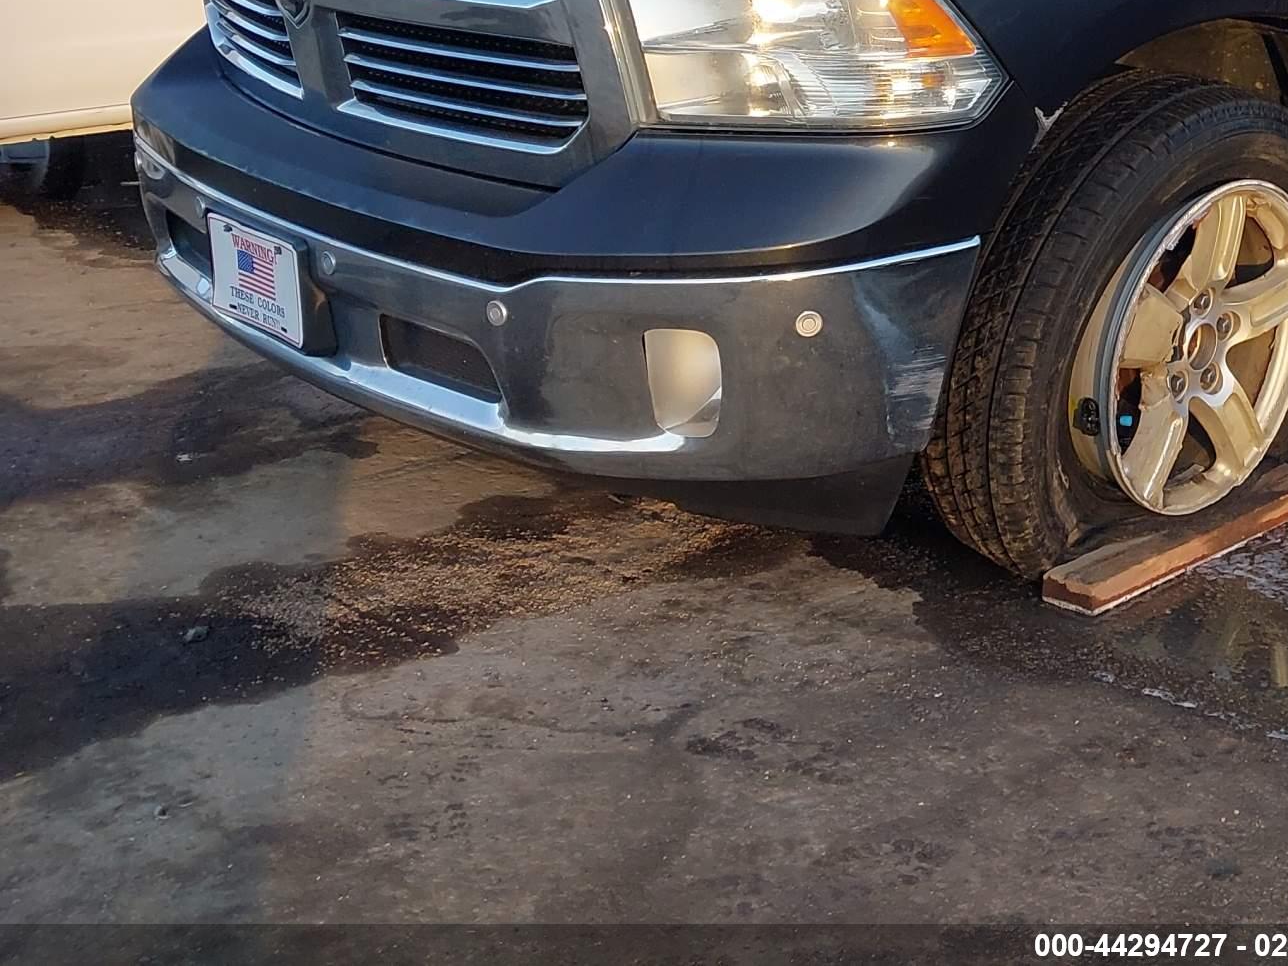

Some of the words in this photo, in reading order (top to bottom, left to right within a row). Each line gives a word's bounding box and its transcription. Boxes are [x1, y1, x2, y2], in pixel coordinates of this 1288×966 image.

[230, 285, 255, 304] THESE
[257, 297, 285, 319] COLORS
[237, 302, 260, 322] NEVER
